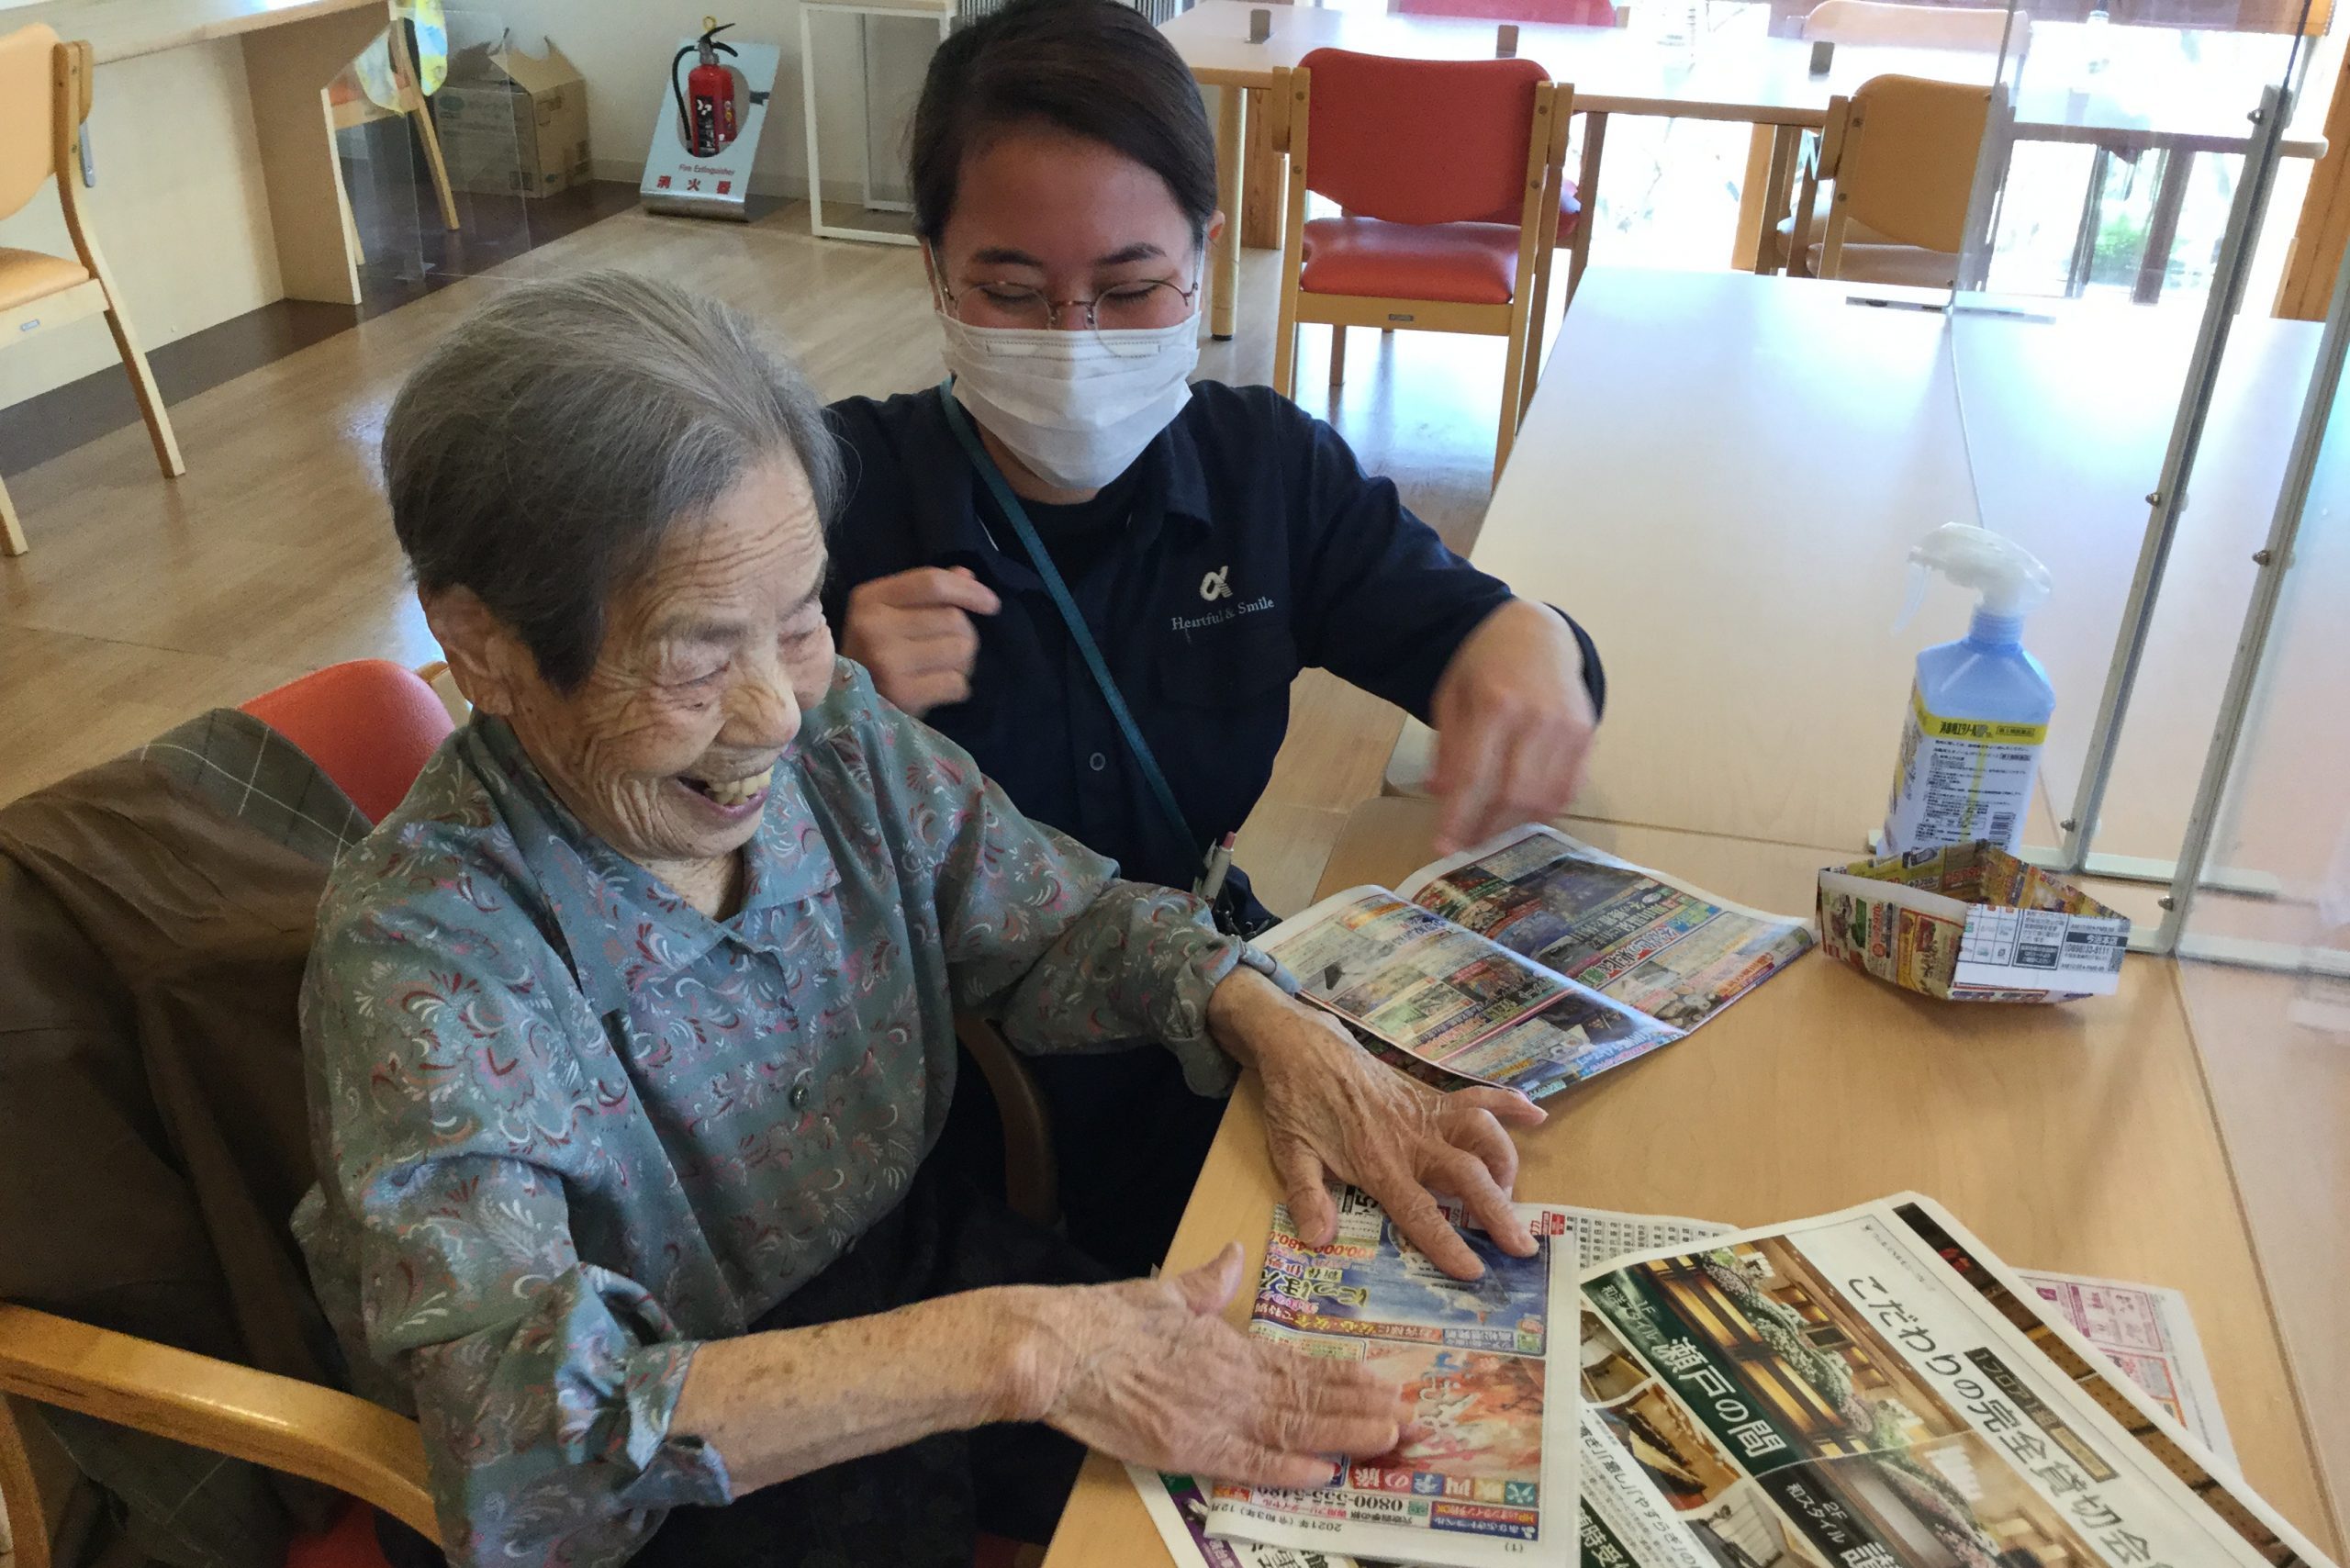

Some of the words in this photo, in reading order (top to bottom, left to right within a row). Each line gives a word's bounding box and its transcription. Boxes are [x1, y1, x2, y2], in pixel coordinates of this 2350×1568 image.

[1170, 610, 1224, 631] Heartful
[1225, 607, 1236, 619] &
[1237, 597, 1275, 614] Smile
[1651, 1336, 1787, 1458] 瀬戸の間
[1848, 1275, 2174, 1568] こだわりの完全貸切会
[1786, 1482, 1847, 1544] 和スタイル
[1823, 1502, 1848, 1521] 2F
